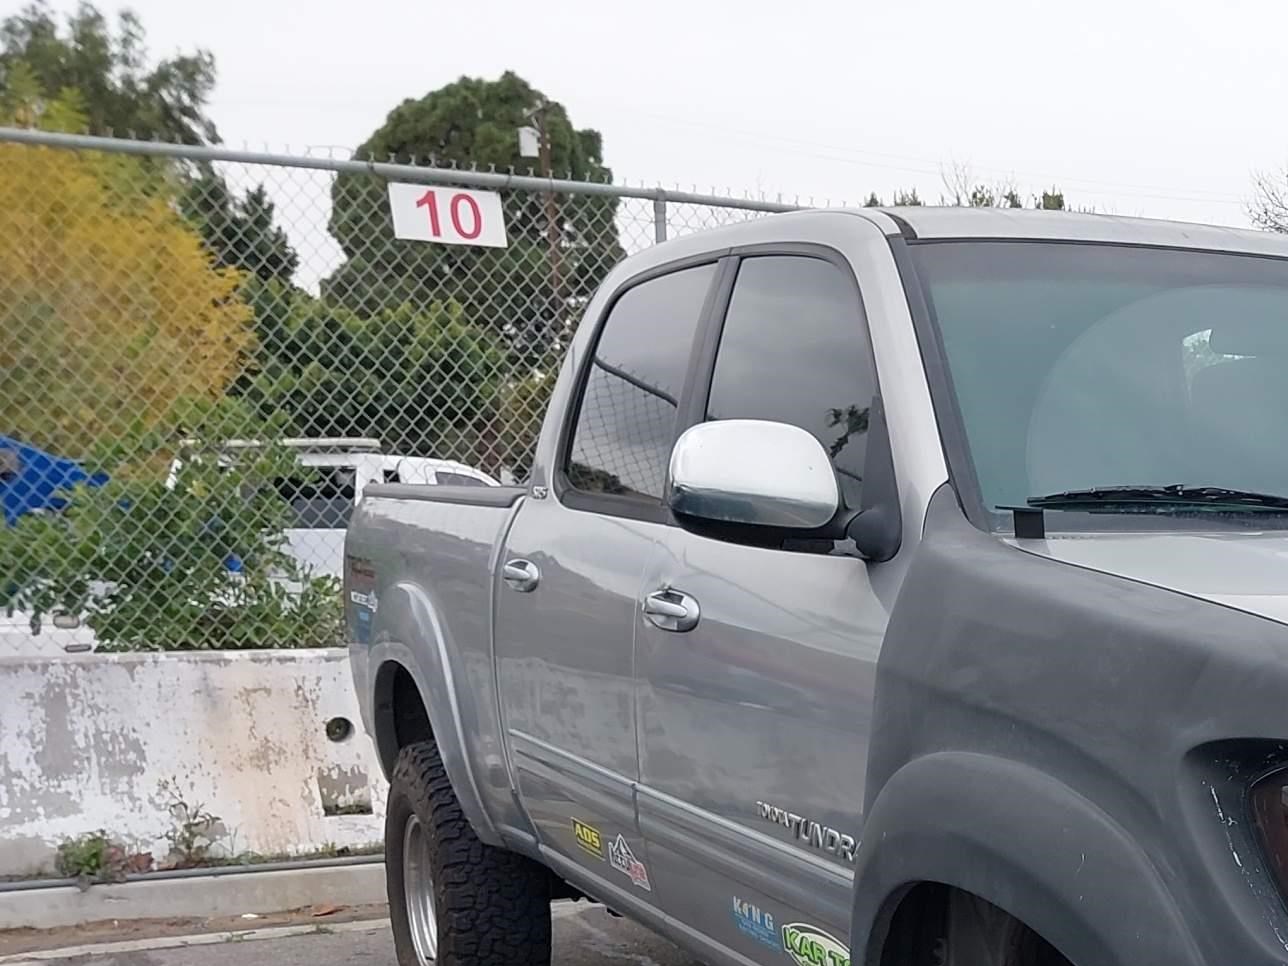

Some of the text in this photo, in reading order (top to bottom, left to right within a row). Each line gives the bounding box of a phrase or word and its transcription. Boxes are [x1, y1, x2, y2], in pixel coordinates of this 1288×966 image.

[416, 190, 482, 239] 10
[756, 801, 790, 828] TOYOTA
[575, 823, 601, 849] ADS
[733, 895, 774, 931] KING
